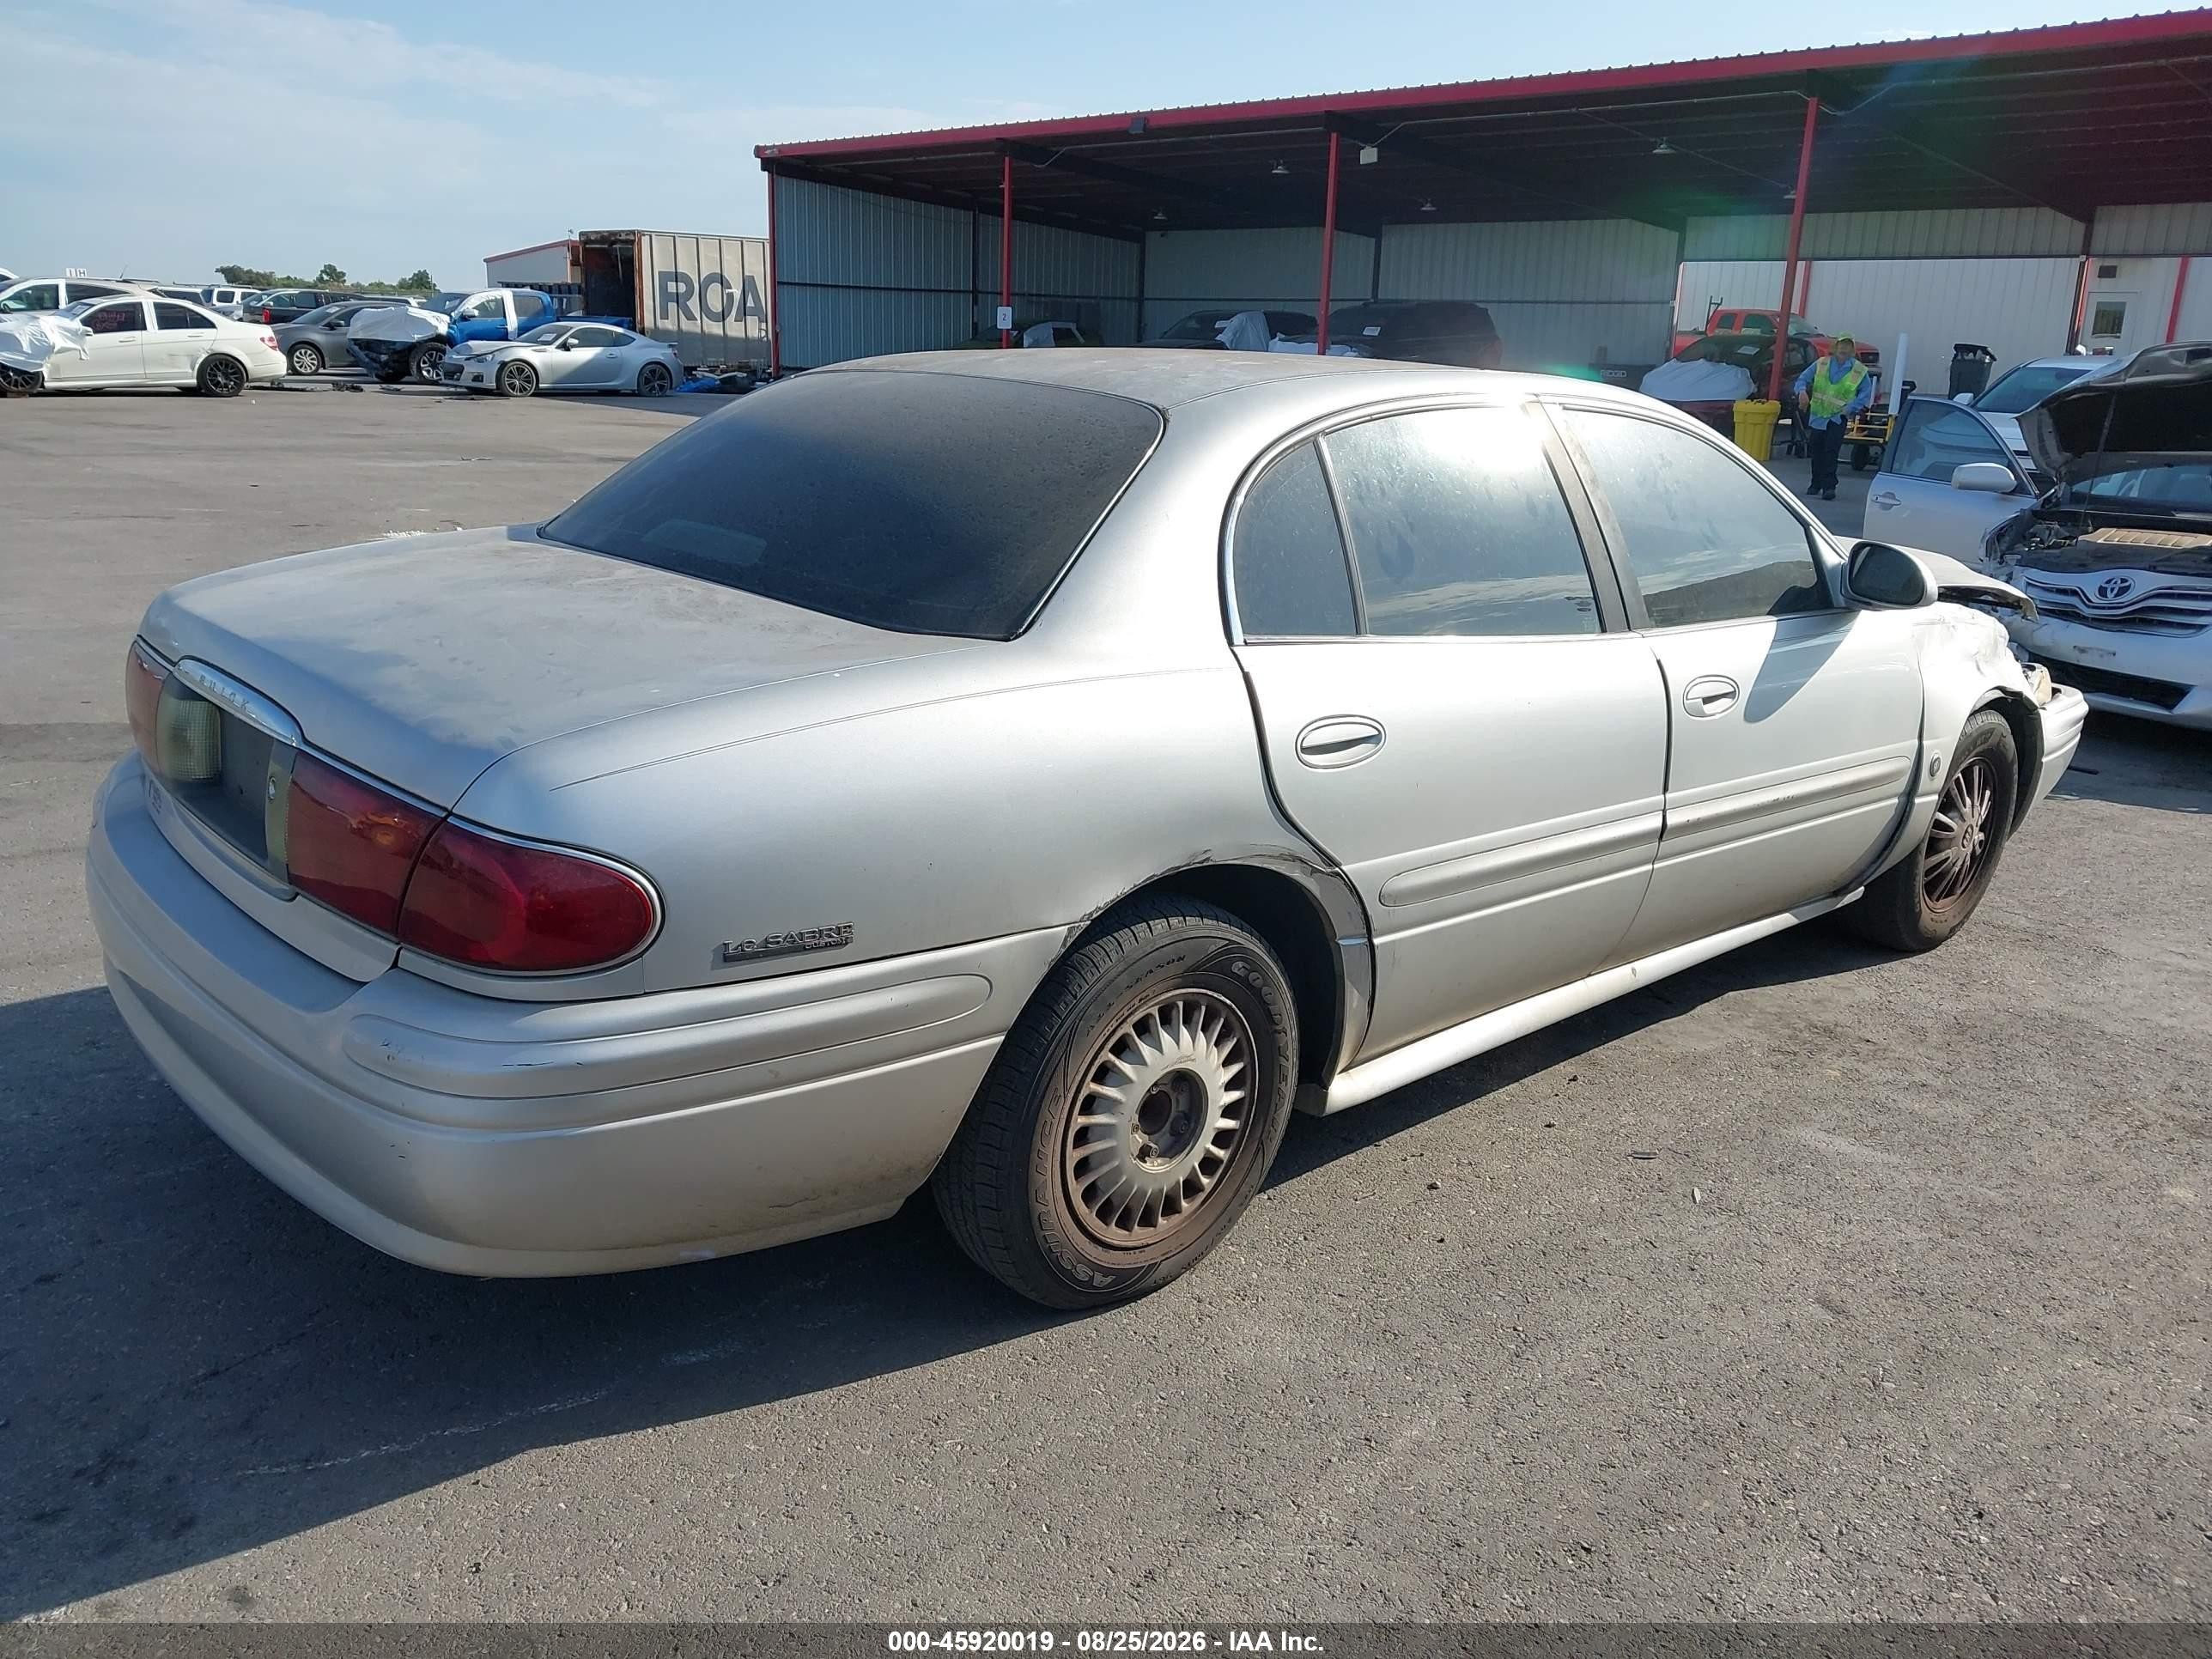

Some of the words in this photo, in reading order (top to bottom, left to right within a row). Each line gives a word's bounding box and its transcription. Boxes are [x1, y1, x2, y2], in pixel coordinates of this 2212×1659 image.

[766, 921, 854, 948] SABRE
[1230, 959, 1291, 1143] GOODYEAR
[1035, 1086, 1117, 1288] ASSURANCE
